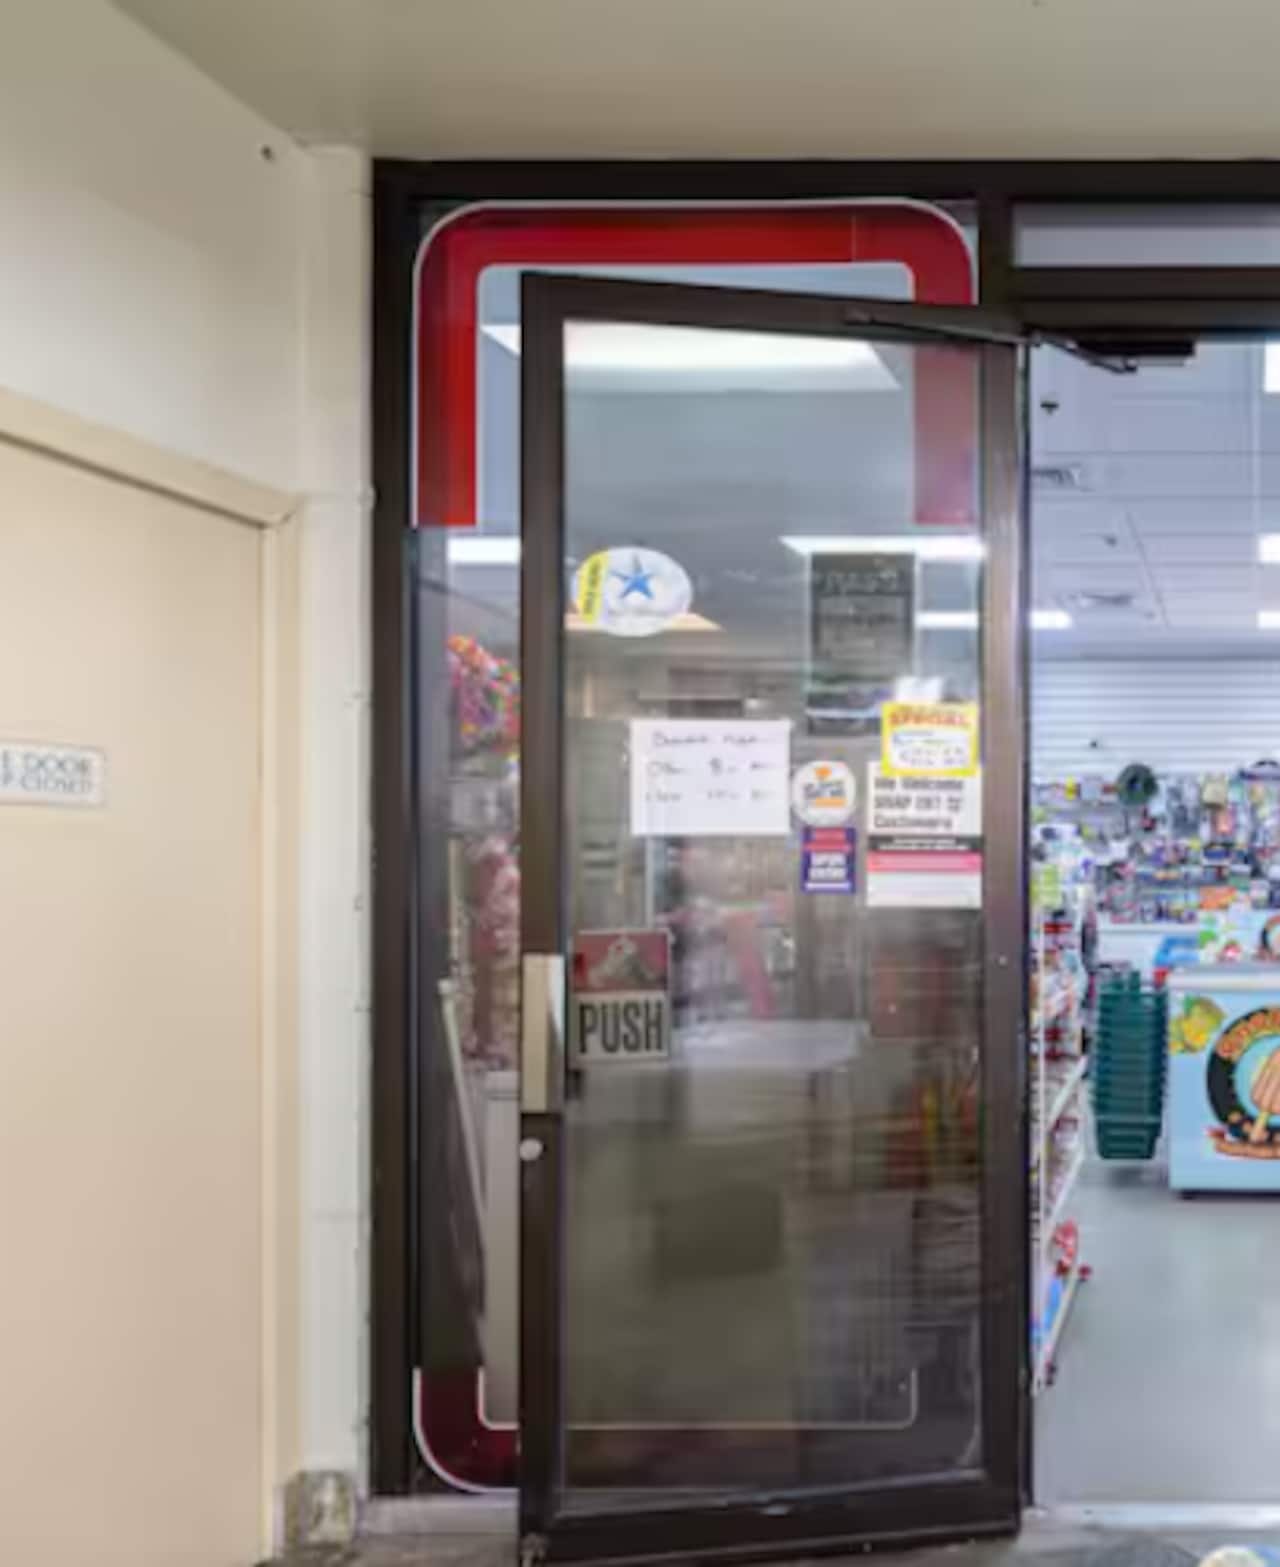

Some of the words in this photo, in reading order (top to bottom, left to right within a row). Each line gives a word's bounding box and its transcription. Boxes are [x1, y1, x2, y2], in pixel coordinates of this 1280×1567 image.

[23, 751, 91, 773] DOOR
[21, 772, 93, 793] CLOSED
[578, 1002, 665, 1053] PUSH
